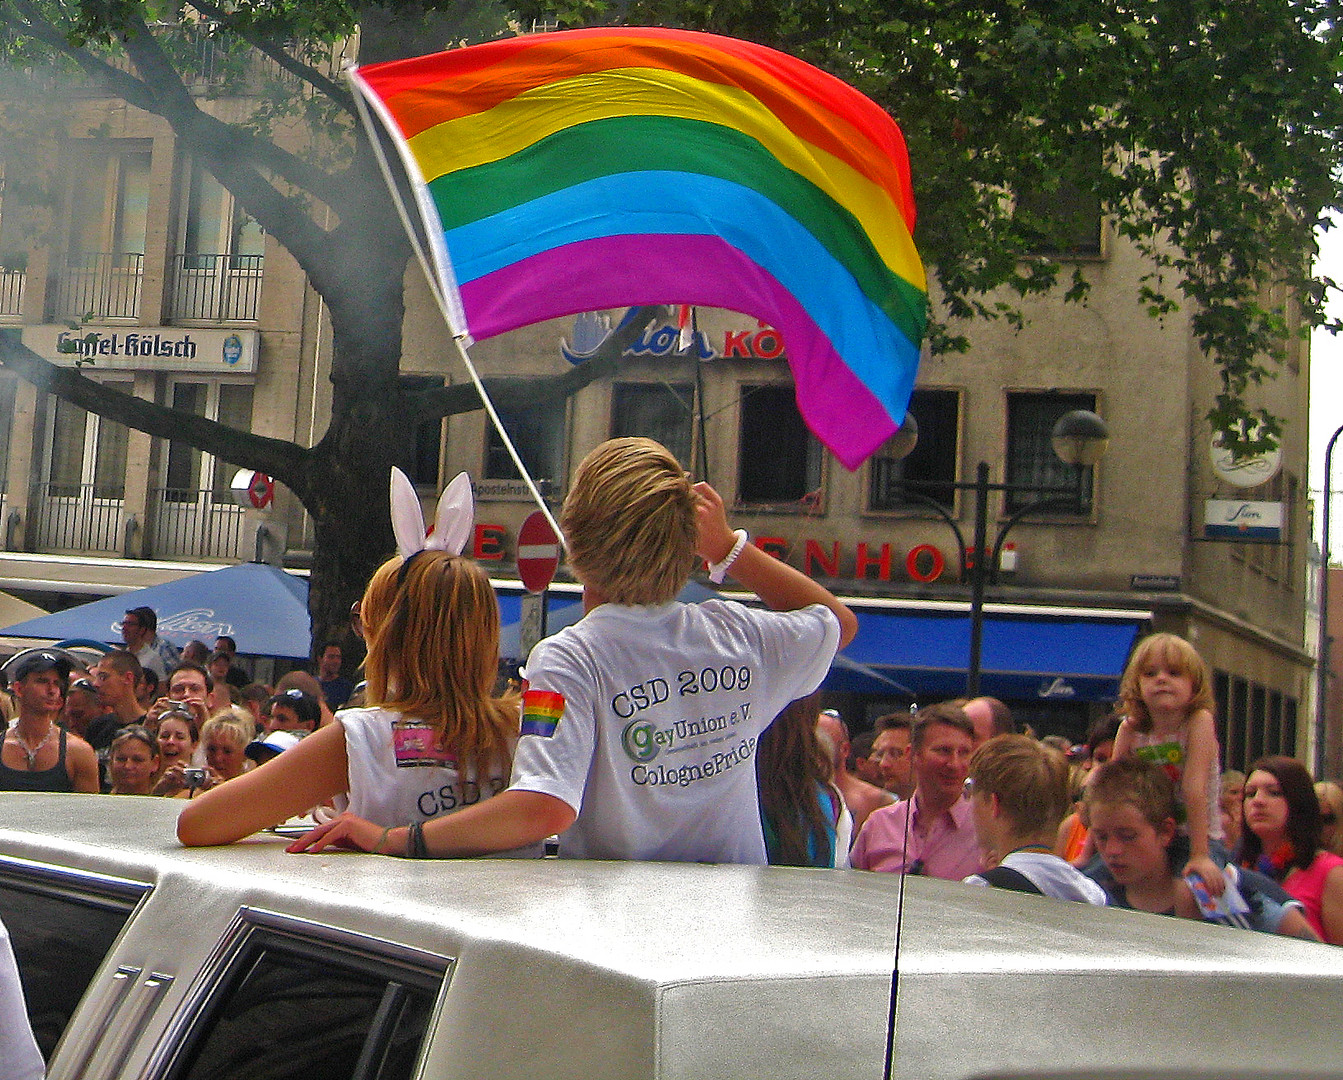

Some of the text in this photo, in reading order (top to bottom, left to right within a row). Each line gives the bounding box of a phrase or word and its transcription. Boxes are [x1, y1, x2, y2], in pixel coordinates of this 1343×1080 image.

[612, 666, 751, 718] CSD 2009
[630, 736, 756, 787] ColognePride
[417, 780, 481, 817] CSD
